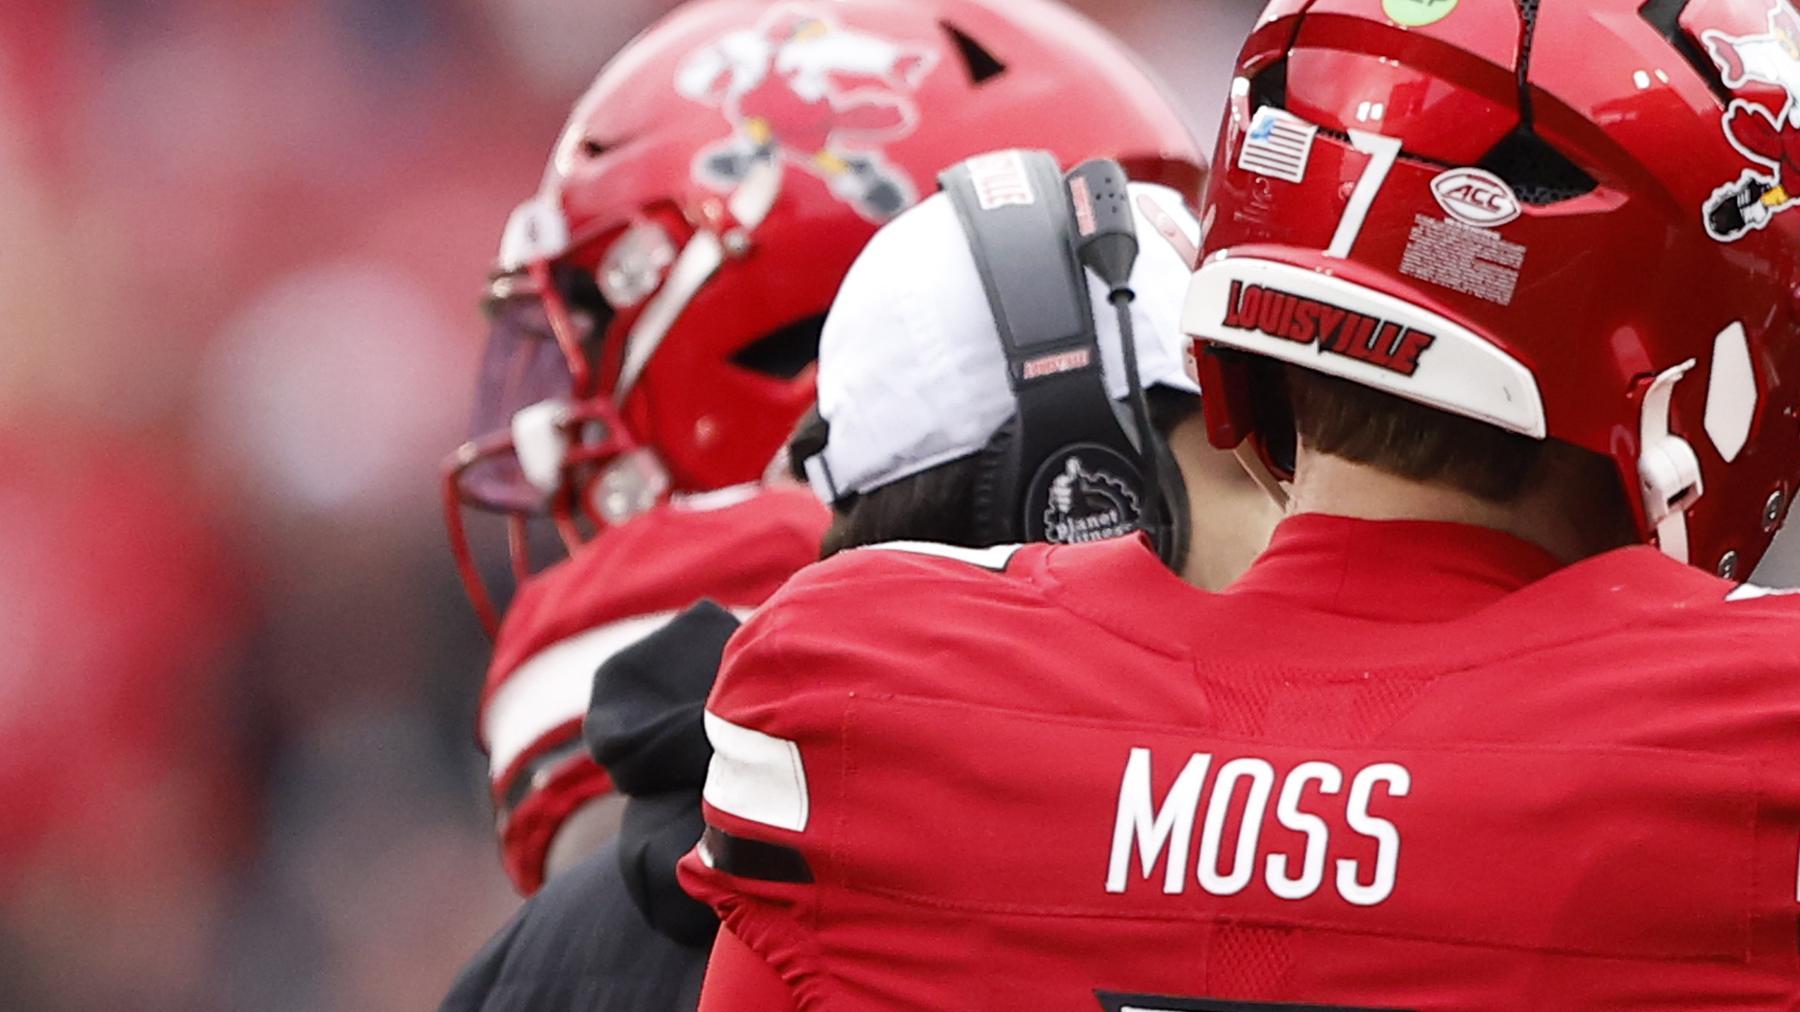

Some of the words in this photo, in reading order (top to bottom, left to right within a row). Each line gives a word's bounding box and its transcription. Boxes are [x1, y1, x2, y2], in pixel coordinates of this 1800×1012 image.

[1322, 128, 1402, 260] 7
[1442, 185, 1501, 213] ACC
[1222, 279, 1436, 378] LOUISVILLE
[1056, 509, 1118, 543] planet
[1104, 747, 1412, 907] MOSS
